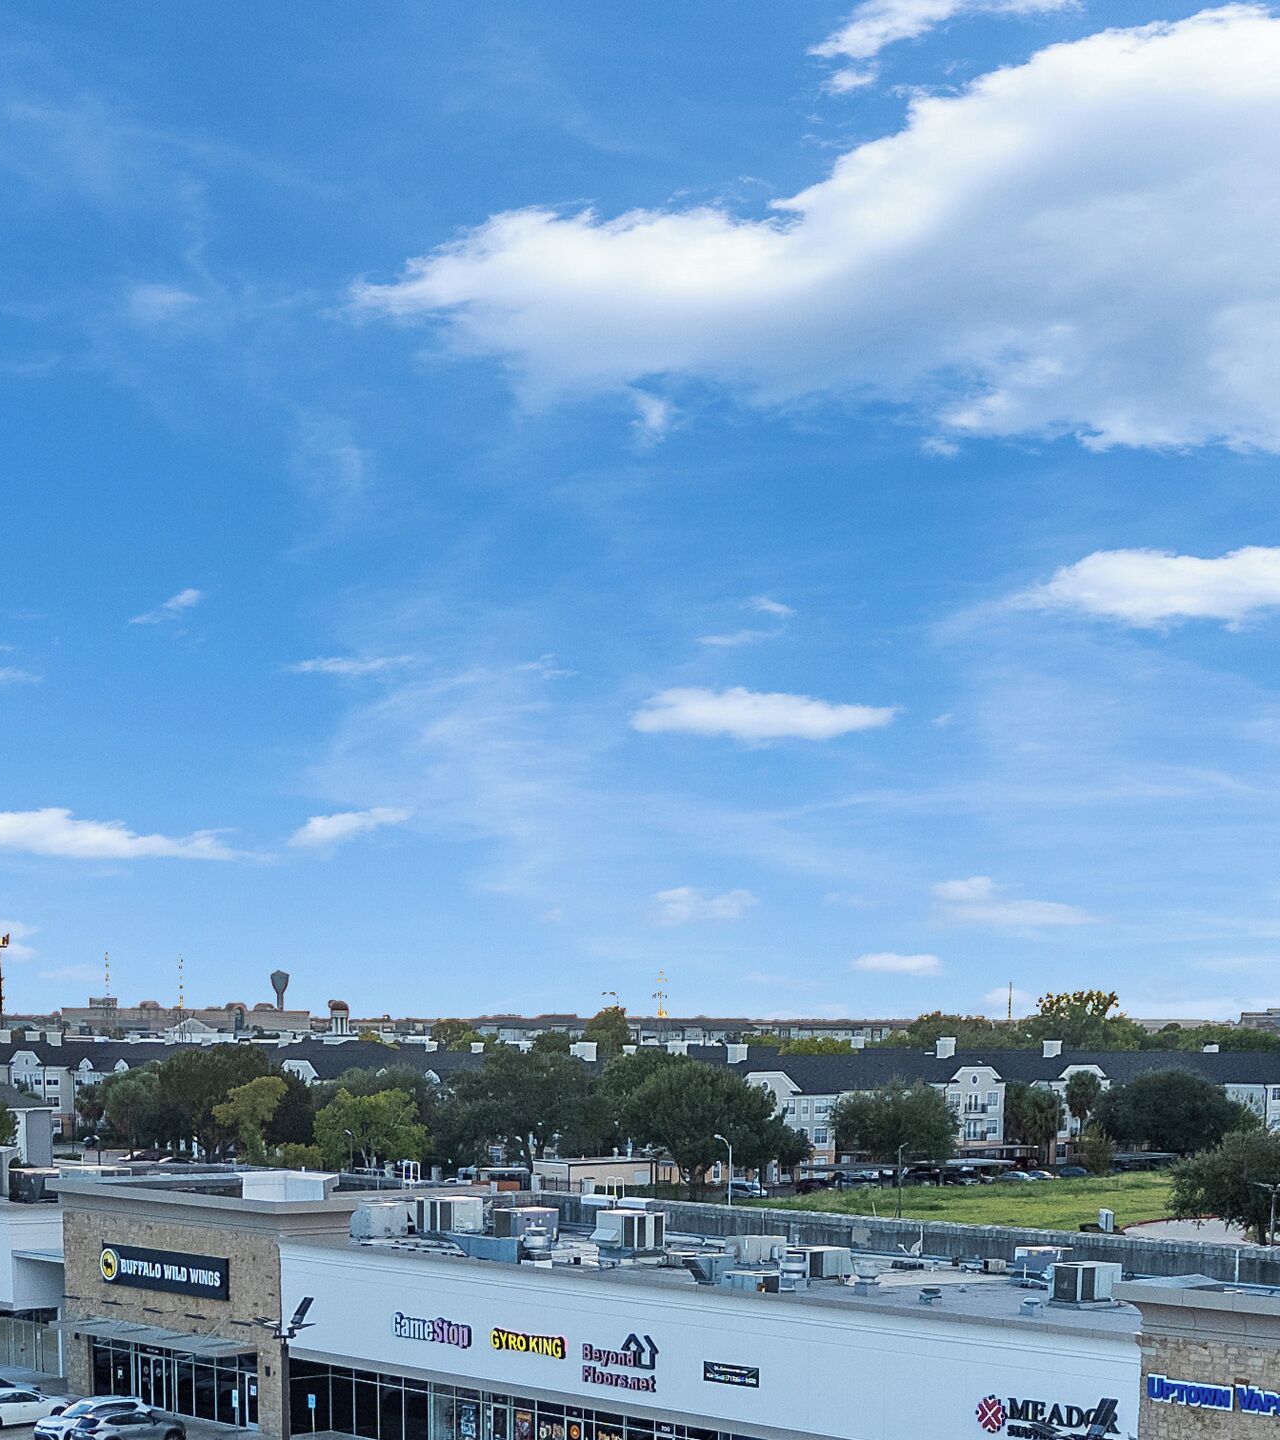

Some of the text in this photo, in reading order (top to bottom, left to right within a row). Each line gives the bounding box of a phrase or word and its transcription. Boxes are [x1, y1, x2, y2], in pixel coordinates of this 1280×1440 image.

[120, 1258, 221, 1287] BUFFALO WILD WINGS
[393, 1312, 472, 1349] GameStop
[490, 1328, 565, 1359] GYRO KING
[582, 1343, 636, 1367] Beyond
[582, 1365, 657, 1393] Floors.net
[1148, 1374, 1233, 1410] UPTOWN
